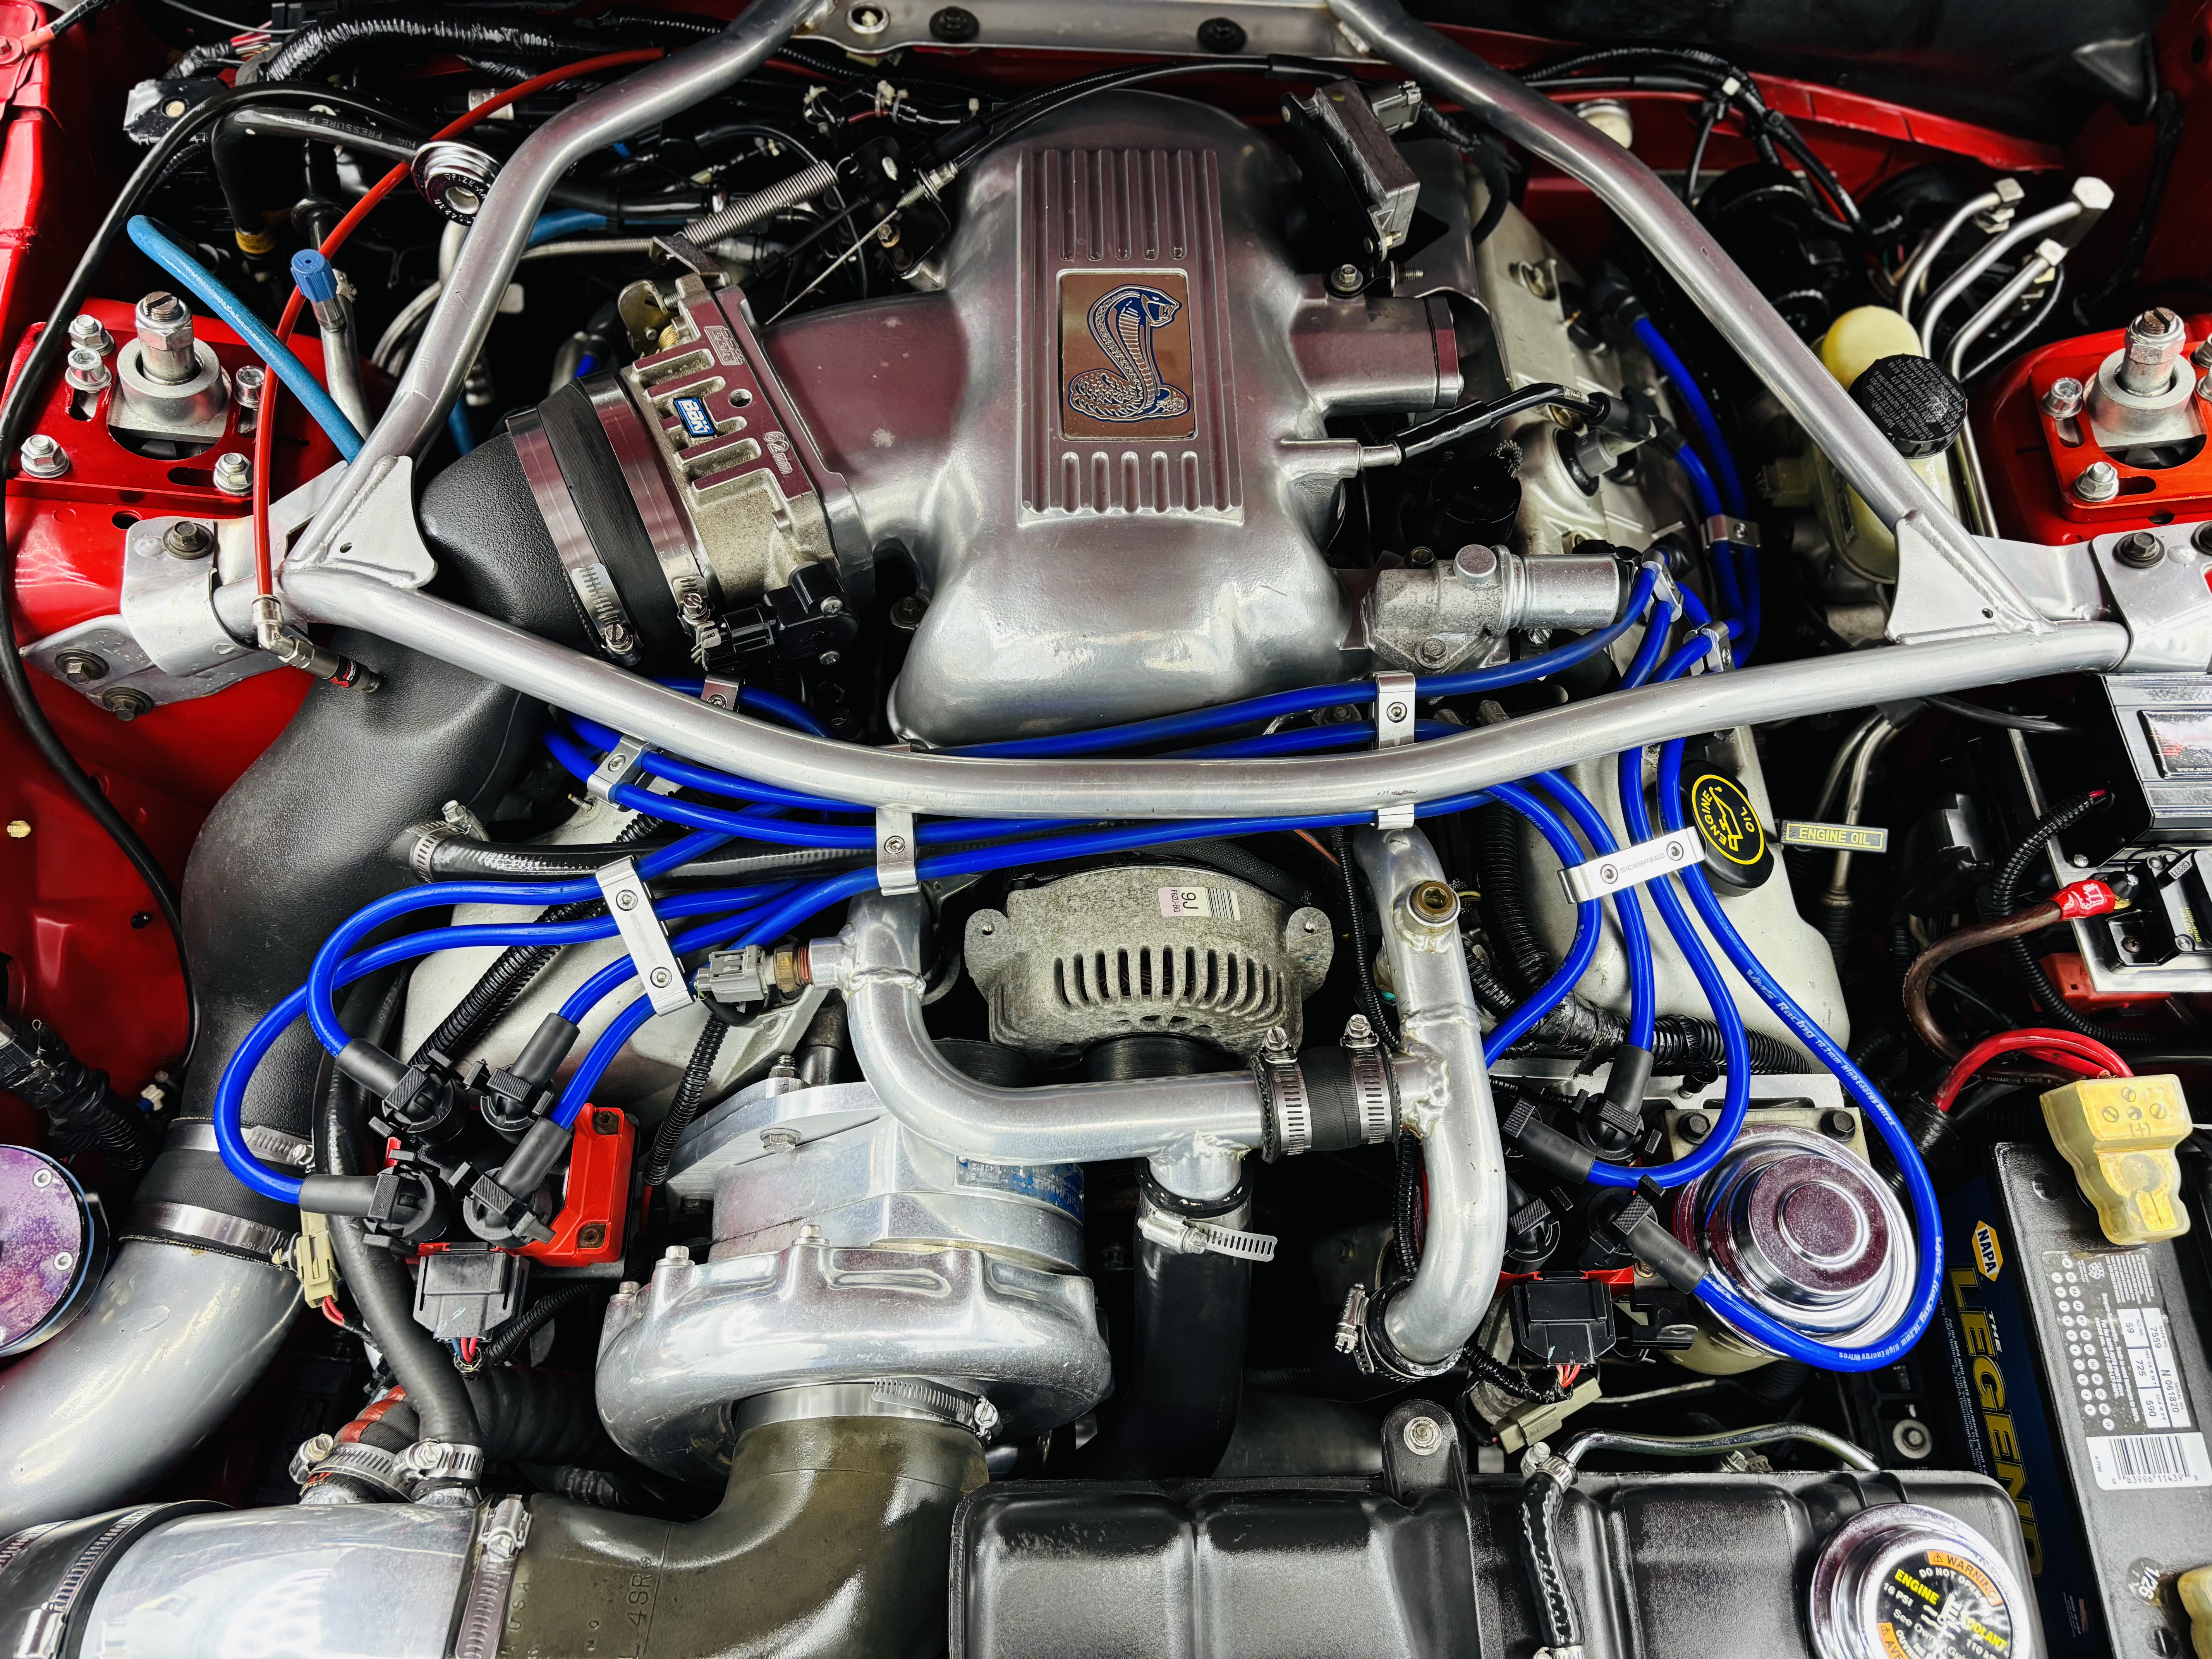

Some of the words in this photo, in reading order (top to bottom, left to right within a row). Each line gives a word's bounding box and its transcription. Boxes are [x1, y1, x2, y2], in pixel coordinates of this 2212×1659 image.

[321, 118, 382, 139] PRESSURE
[680, 400, 711, 434] BBK
[763, 431, 793, 475] 62mm
[1701, 790, 1727, 845] ENGINE
[1740, 806, 1755, 832] OIL
[1799, 827, 1846, 843] ENGINE
[1850, 833, 1871, 845] OIL
[1620, 853, 1665, 873] SICKSPEED
[1170, 890, 1181, 912] F6ZU-BG
[1181, 892, 1199, 909] 9J
[2178, 907, 2193, 935] VB100
[2184, 906, 2202, 943] 100A-4AWG
[1746, 968, 1777, 999] VMS
[1776, 1001, 1816, 1039] Racing
[1814, 1039, 1841, 1065] 10.2mm
[1840, 1063, 1858, 1082] High
[1855, 1079, 1878, 1104] Energy
[1875, 1102, 1895, 1126] Wires
[1975, 1228, 1999, 1273] NAPA
[1918, 1278, 1939, 1323] Racing
[1899, 1324, 1920, 1346] 10.2mm
[1944, 1317, 1952, 1338] NAPA
[1987, 1311, 2002, 1353] THE
[2125, 1321, 2135, 1334] 59
[2149, 1326, 2162, 1348] 7559
[1861, 1350, 1884, 1360] Energy
[1885, 1343, 1899, 1355] High
[2105, 1336, 2114, 1352] NAPA
[1839, 1352, 1860, 1361] Wires
[2109, 1350, 2118, 1366] AUTO
[2112, 1365, 2122, 1383] PARTS
[2135, 1359, 2147, 1377] 725
[2160, 1368, 2171, 1378] N
[2164, 1379, 2179, 1413] 061820
[2145, 1399, 2156, 1417] 590
[1946, 1263, 2044, 1581] LEGEND
[1959, 1397, 1971, 1438] Distribution
[1968, 1439, 1978, 1466] Centers
[1970, 1414, 1979, 1438] nearest
[2126, 1474, 2153, 1484] 83996
[2158, 1473, 2183, 1482] 11439
[1919, 1568, 1933, 1578] DO
[1935, 1567, 1956, 1579] NOT
[1947, 1554, 1998, 1600] WARNING
[2138, 1566, 2161, 1600] 1/26
[1883, 1582, 1895, 1595] 16
[1895, 1589, 1914, 1607] PSI
[1894, 1568, 1939, 1605] ENGINE
[1893, 1608, 1913, 1626] See
[1966, 1638, 1984, 1655] 110
